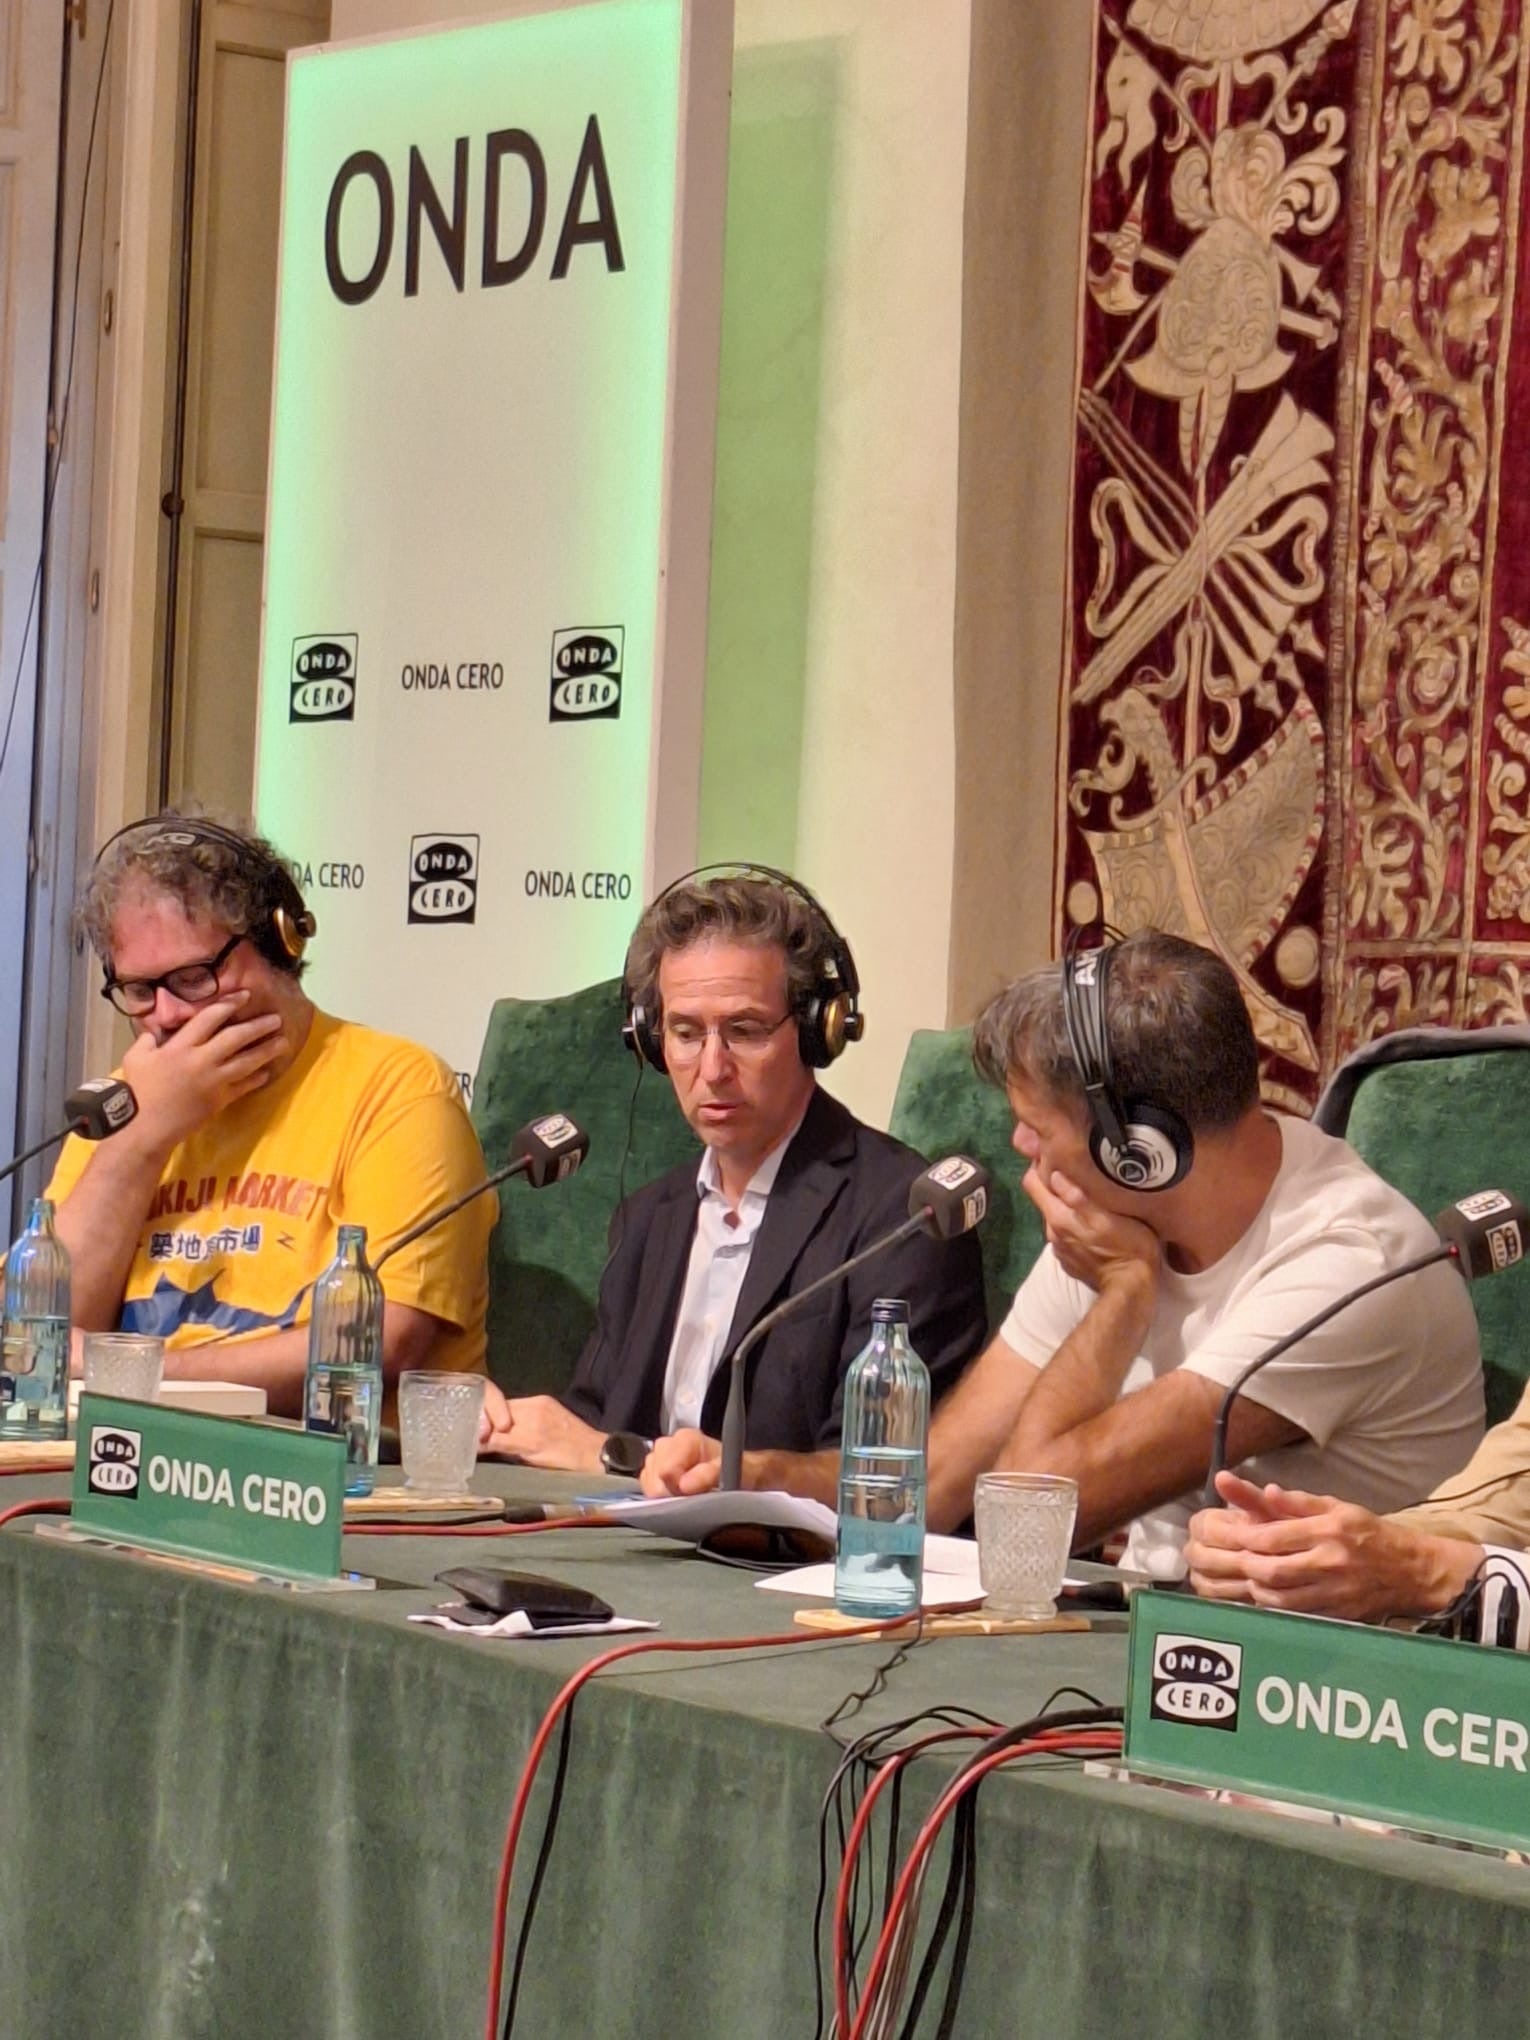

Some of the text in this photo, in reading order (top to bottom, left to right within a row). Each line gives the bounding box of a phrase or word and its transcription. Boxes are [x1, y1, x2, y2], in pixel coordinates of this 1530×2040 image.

[325, 113, 625, 306] ONDA
[300, 653, 347, 673] ONDA
[561, 647, 613, 668] ONDA
[401, 662, 504, 690] ONDA CERO
[302, 687, 345, 707] CERO
[563, 683, 610, 705] CERO
[291, 861, 364, 889] DA CERO
[419, 853, 468, 872] ONDA
[421, 888, 466, 908] CERO
[525, 870, 632, 900] ONDA CERO
[146, 1176, 217, 1221] KIJI
[149, 1455, 326, 1525] ONDA CERO
[1165, 1652, 1228, 1678] ONDA
[1167, 1688, 1225, 1713] CERO
[1256, 1676, 1528, 1773] ONDA CER
